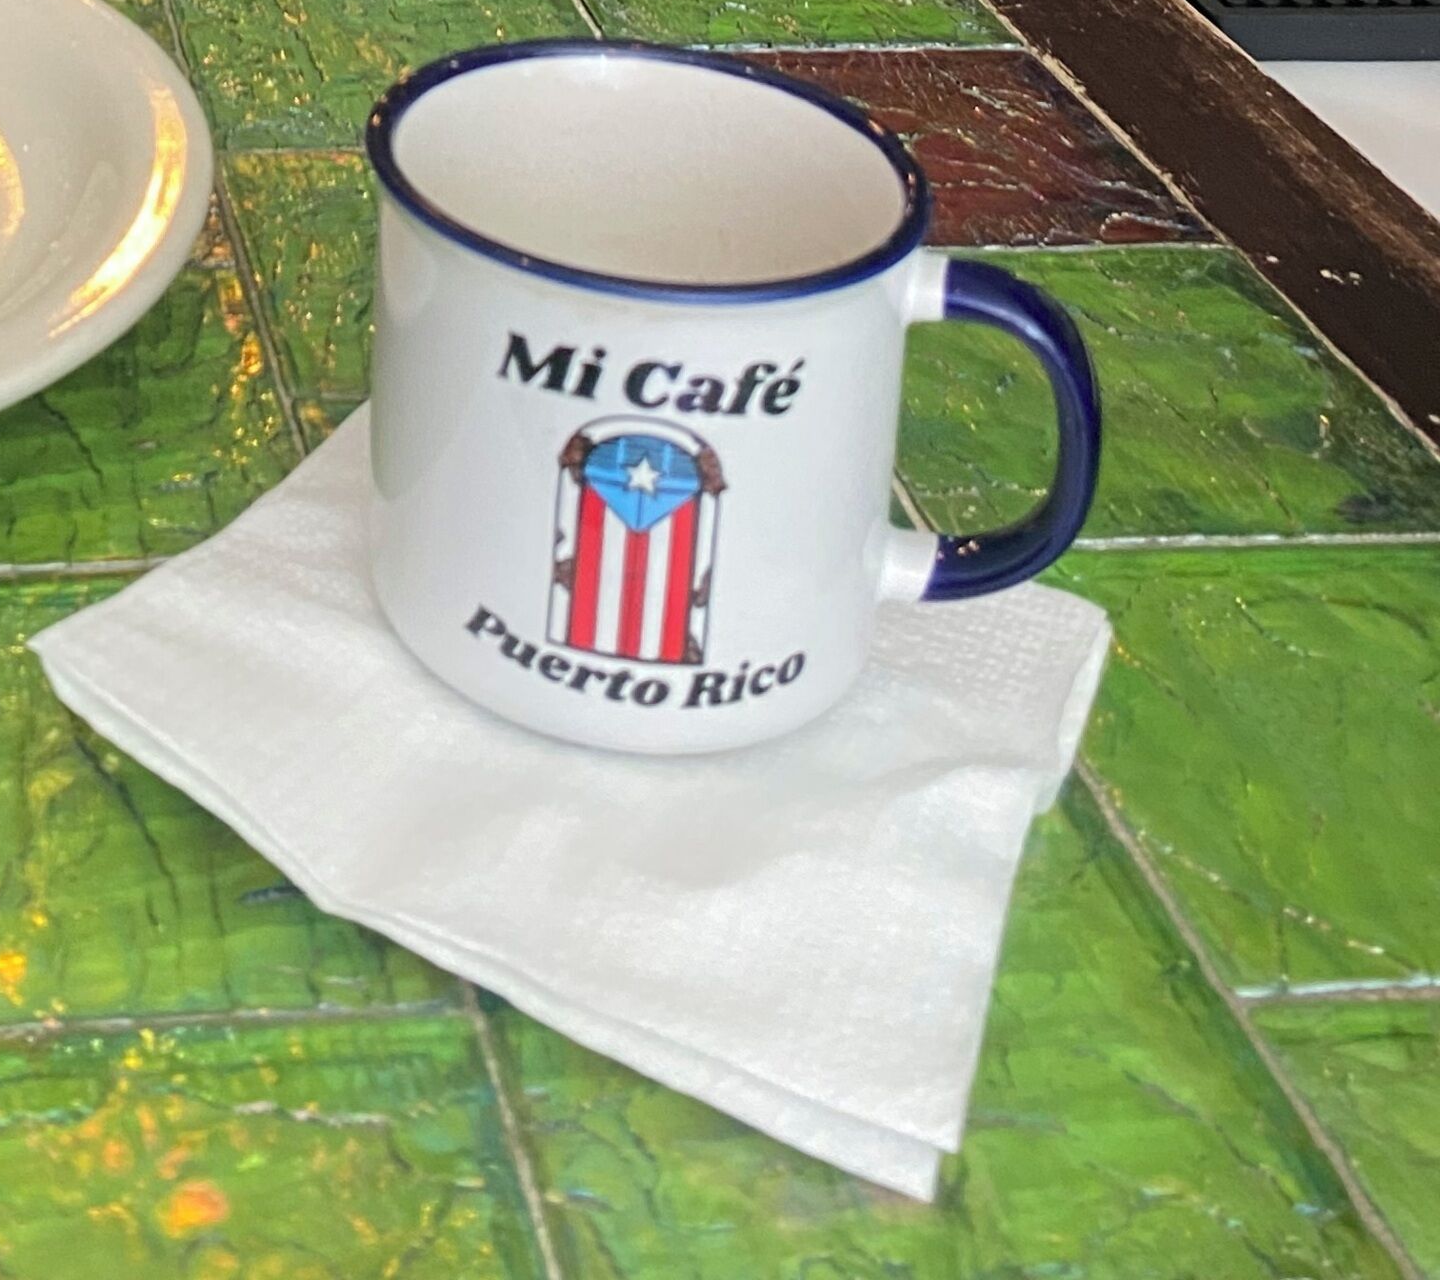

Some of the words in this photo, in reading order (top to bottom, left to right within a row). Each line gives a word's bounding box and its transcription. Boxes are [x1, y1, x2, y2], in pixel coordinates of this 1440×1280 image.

[497, 331, 608, 400] Mi
[623, 357, 807, 417] Café
[464, 604, 670, 708] Puerto
[681, 650, 807, 709] Rico
